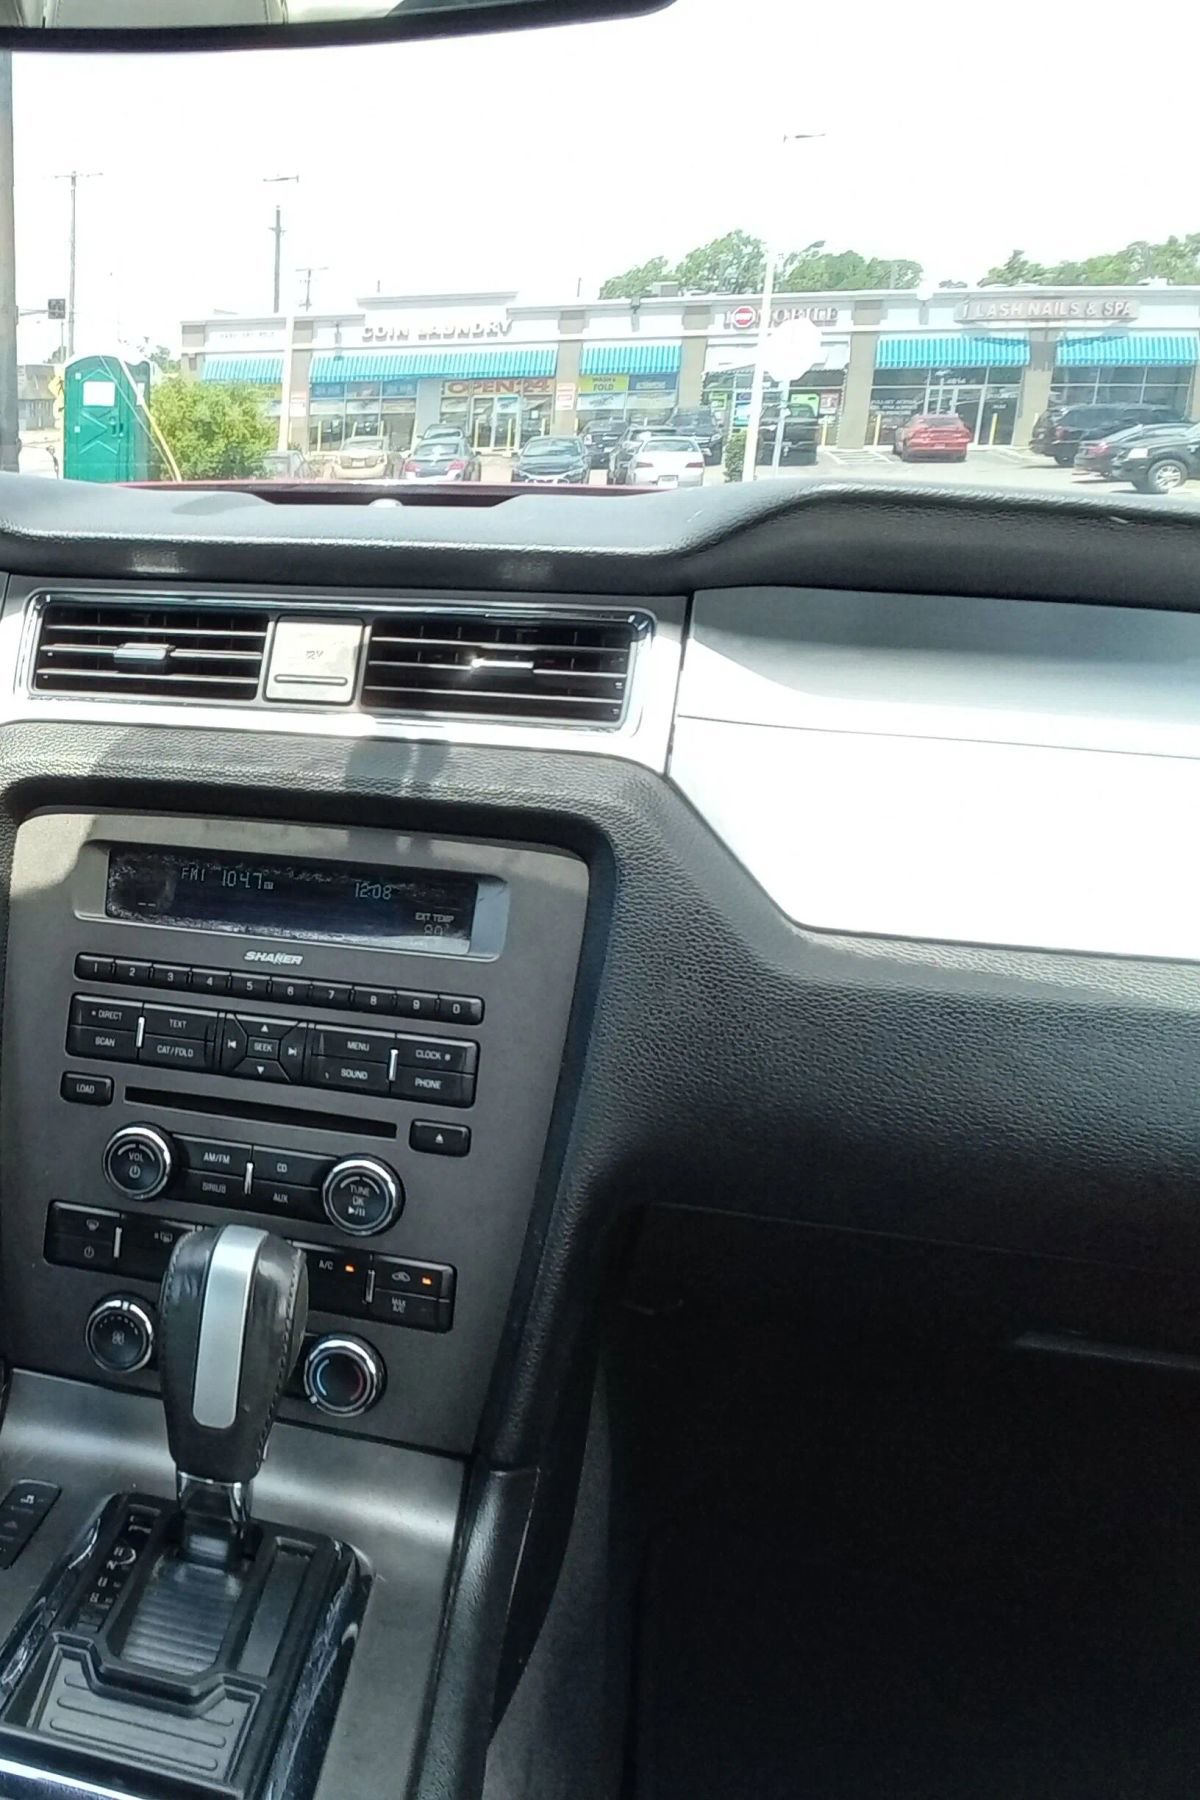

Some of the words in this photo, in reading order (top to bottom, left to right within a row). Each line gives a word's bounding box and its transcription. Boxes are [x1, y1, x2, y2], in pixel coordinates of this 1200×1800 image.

[975, 301, 1023, 318] LASH
[1026, 300, 1079, 316] NAILS
[1085, 301, 1098, 316] &
[1102, 300, 1132, 316] SPA
[361, 324, 410, 343] COIN
[448, 379, 514, 395] OPEN
[593, 383, 615, 391] FOLD
[181, 867, 205, 882] FM1
[415, 911, 432, 922] EXT
[243, 950, 304, 966] SHAKER
[128, 967, 137, 977] 2
[166, 971, 175, 982] 3
[205, 976, 214, 987] 4
[246, 981, 254, 992] 5
[286, 985, 295, 996] 6
[327, 989, 336, 1000] 7
[369, 995, 378, 1006] 8
[412, 999, 421, 1010] 9
[98, 1007, 123, 1020] DIRECT
[169, 1018, 187, 1029] TEXT
[95, 1036, 116, 1047] SCAN
[254, 1042, 273, 1052] SEEK
[347, 1041, 370, 1051] MENU
[156, 1044, 194, 1058] CAT/FOLD
[415, 1050, 441, 1060] CLOCK
[341, 1068, 368, 1080] SOUND
[76, 1083, 95, 1094] LOAD
[415, 1077, 442, 1090] PHONE
[128, 1151, 144, 1162] VOL
[203, 1151, 231, 1164] AM/FM
[276, 1162, 288, 1173] CD
[349, 1184, 370, 1197] TUNE
[272, 1192, 288, 1203] AUX
[352, 1197, 365, 1206] OK
[318, 1259, 334, 1271] A/C
